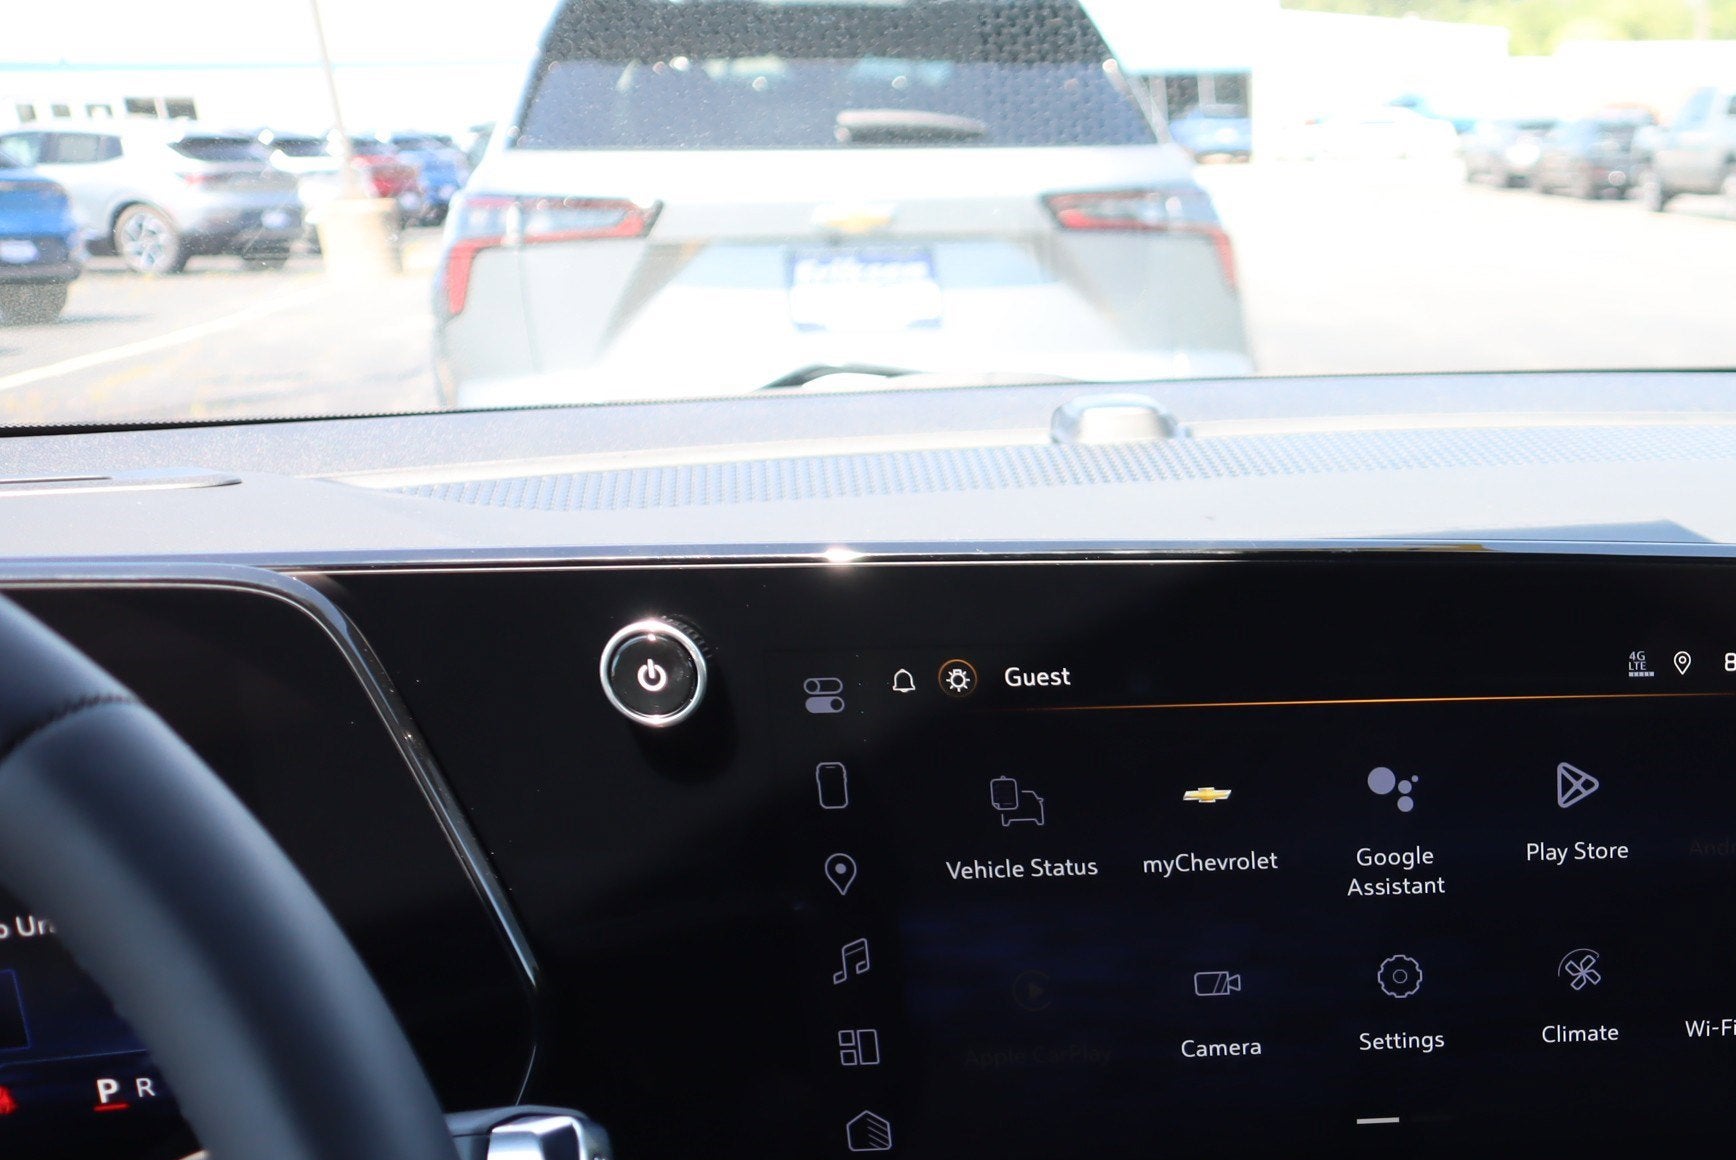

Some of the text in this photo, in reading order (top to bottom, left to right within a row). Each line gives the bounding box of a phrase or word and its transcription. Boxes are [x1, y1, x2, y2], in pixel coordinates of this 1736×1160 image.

[1628, 650, 1646, 662] 4G
[1004, 666, 1072, 689] Guest
[1142, 850, 1279, 878] myChevrolet
[1355, 846, 1435, 870] Google
[1526, 840, 1630, 865] Play Store
[946, 856, 1099, 881] Vehicle Status
[1347, 874, 1446, 898] Assistant
[1358, 1031, 1446, 1054] Settings
[1541, 1024, 1620, 1044] Climate
[1180, 1038, 1263, 1059] Camera
[96, 1077, 156, 1104] P R
